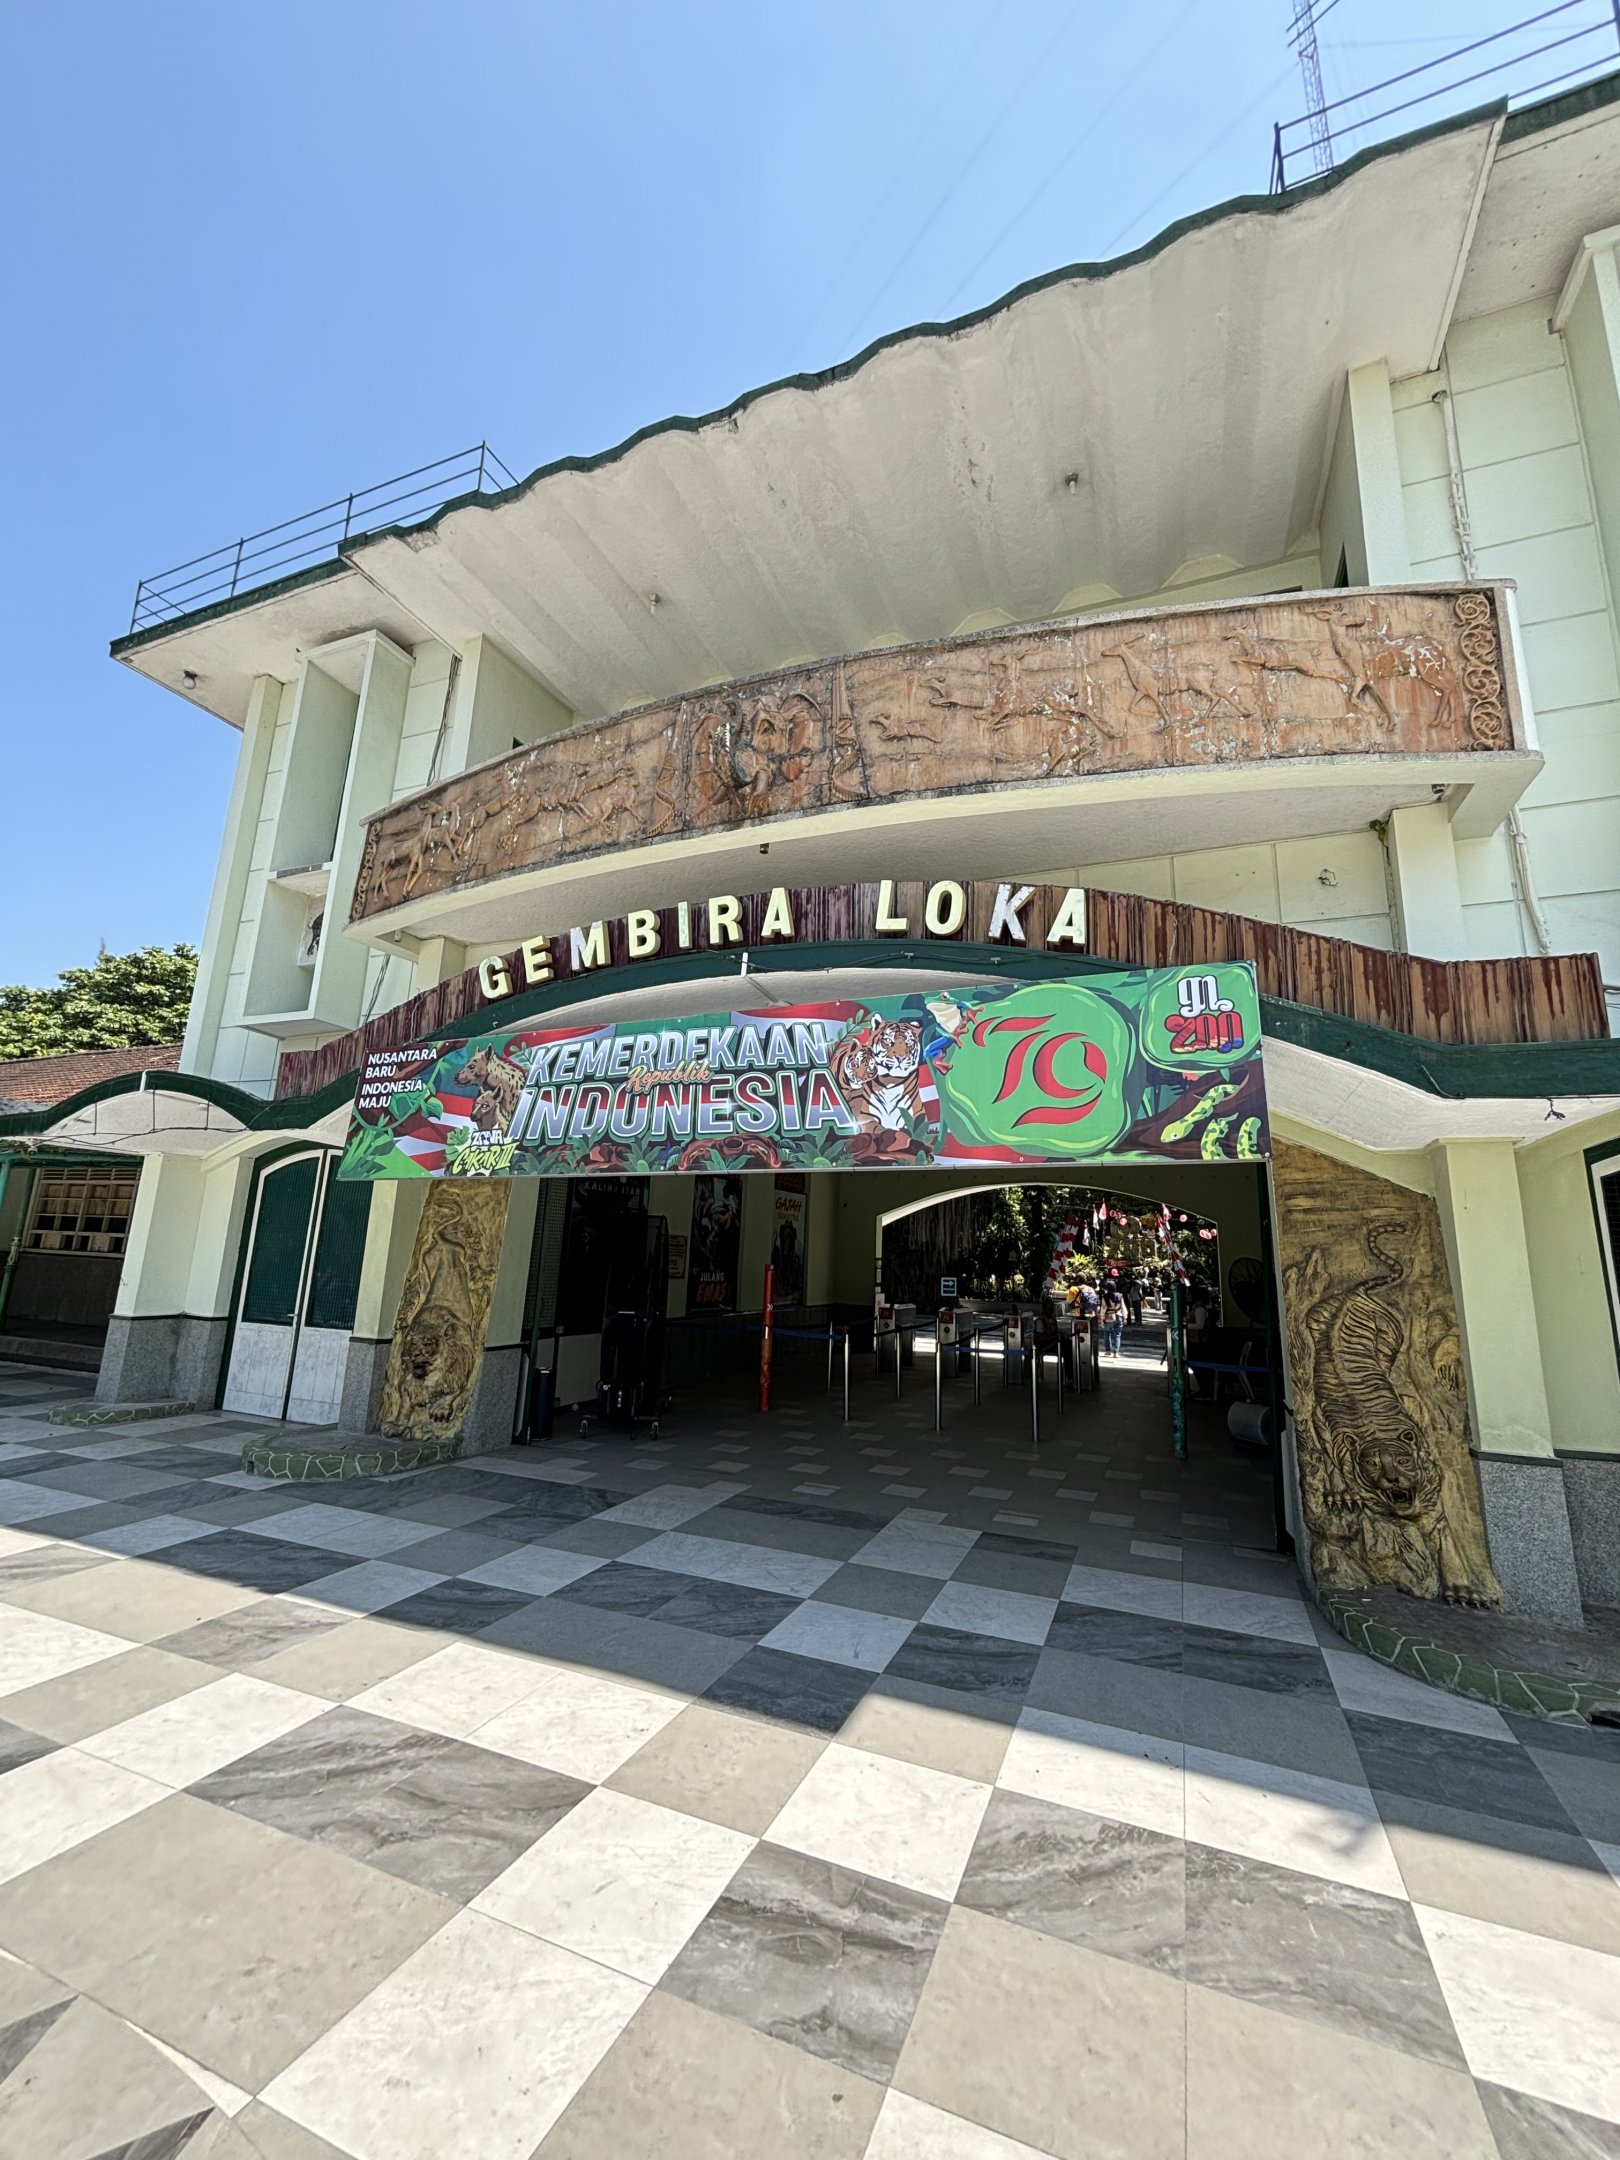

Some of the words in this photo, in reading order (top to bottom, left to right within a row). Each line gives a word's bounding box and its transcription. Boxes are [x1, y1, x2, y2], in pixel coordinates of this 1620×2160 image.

[479, 887, 795, 1000] GEMBIRA
[875, 880, 1088, 946] LOKA
[368, 1048, 438, 1065] NUSANTARA
[527, 1022, 832, 1085] KEMERDEKAAN
[365, 1065, 397, 1079] BARU
[624, 1058, 714, 1094] Republik
[972, 1014, 1107, 1128] 79
[361, 1079, 423, 1095] INDONESIA
[358, 1096, 392, 1109] MAJU
[509, 1071, 857, 1141] INDONESIA
[775, 1196, 802, 1213] GAJAH
[700, 1271, 726, 1282] JULANG
[696, 1282, 728, 1303] EMAS
